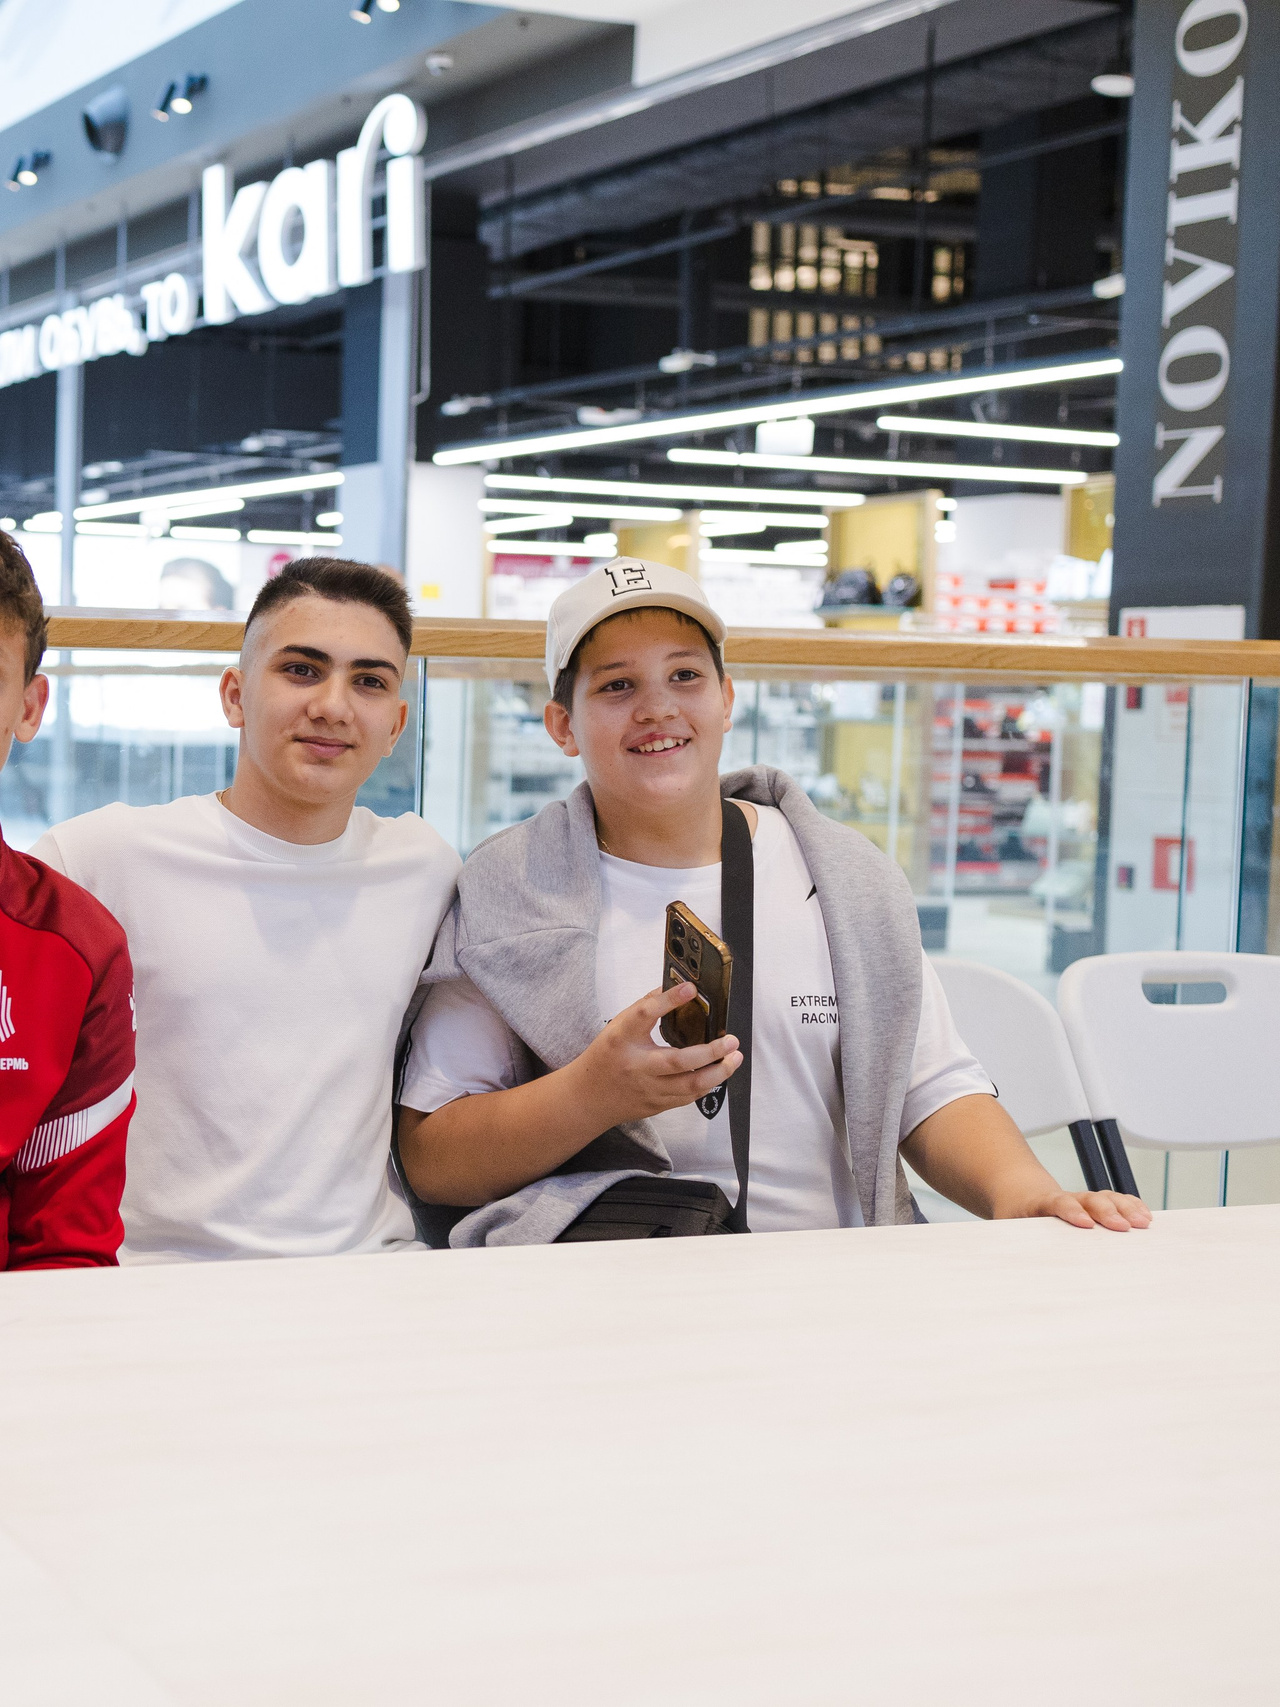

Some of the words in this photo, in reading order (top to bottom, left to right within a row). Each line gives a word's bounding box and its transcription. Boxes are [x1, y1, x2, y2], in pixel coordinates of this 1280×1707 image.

[201, 93, 425, 325] kari
[1152, 0, 1249, 507] NOVIKO
[140, 272, 197, 342] ТО
[604, 563, 652, 596] E
[801, 1012, 839, 1024] RACIN
